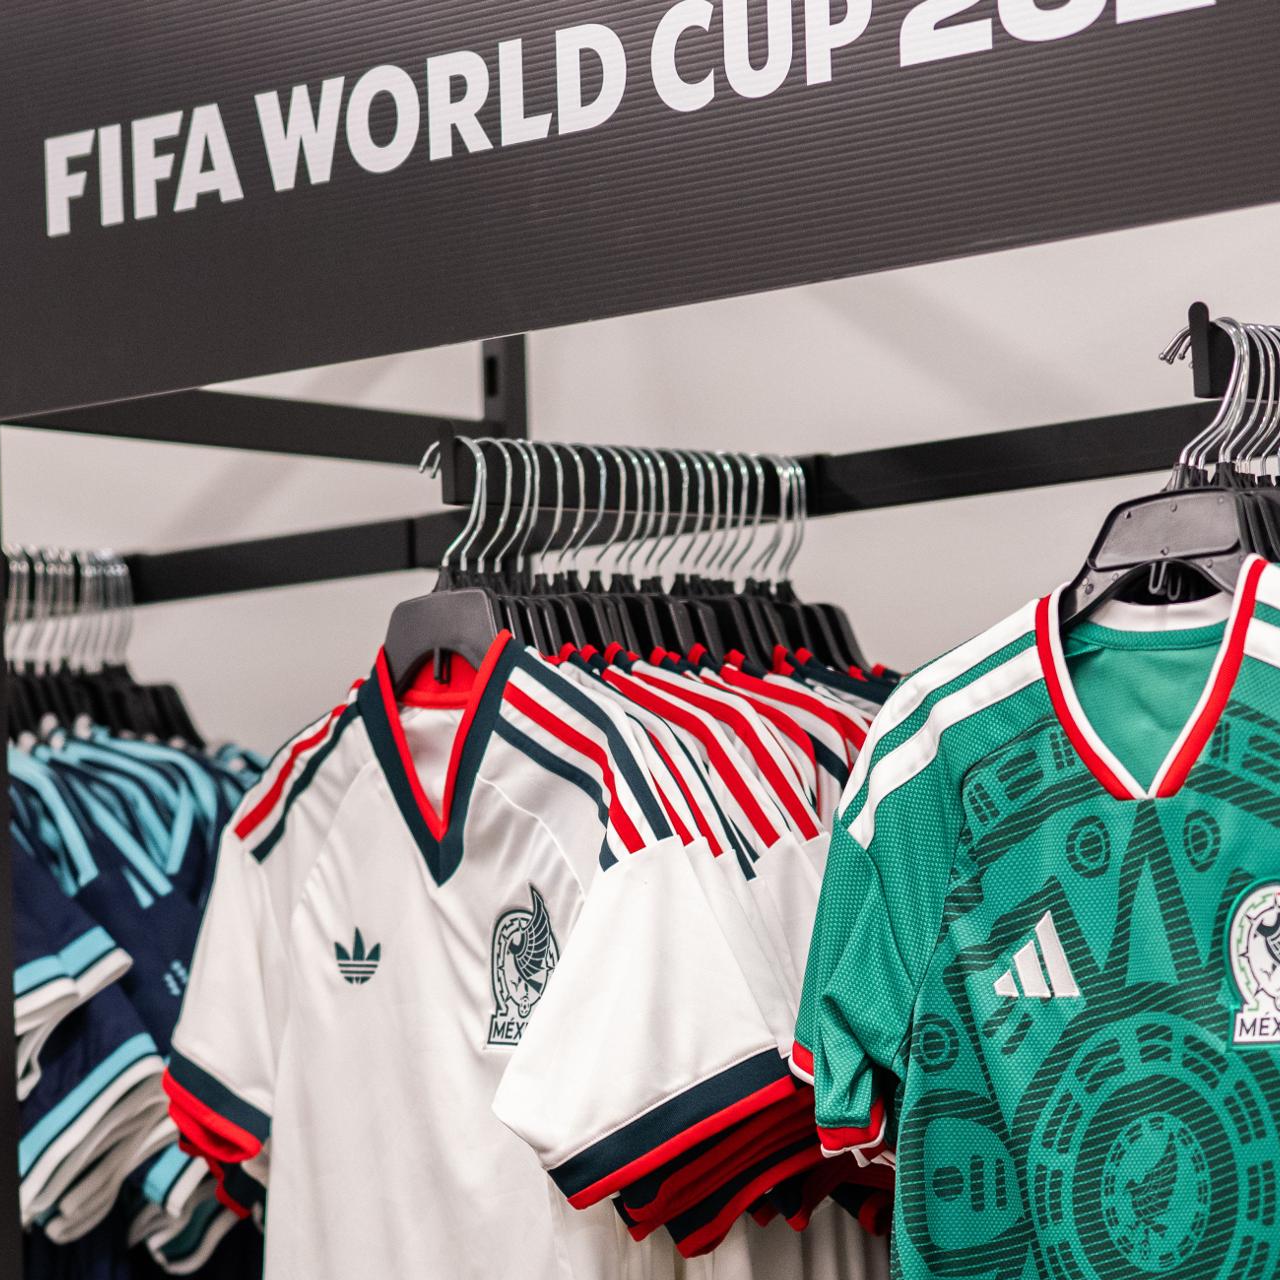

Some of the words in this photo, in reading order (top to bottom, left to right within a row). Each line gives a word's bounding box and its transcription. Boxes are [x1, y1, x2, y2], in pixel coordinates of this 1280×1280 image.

[44, 102, 245, 238] FIFA
[253, 22, 628, 192] WORLD
[650, 0, 873, 112] CUP
[492, 1017, 528, 1040] MÉX
